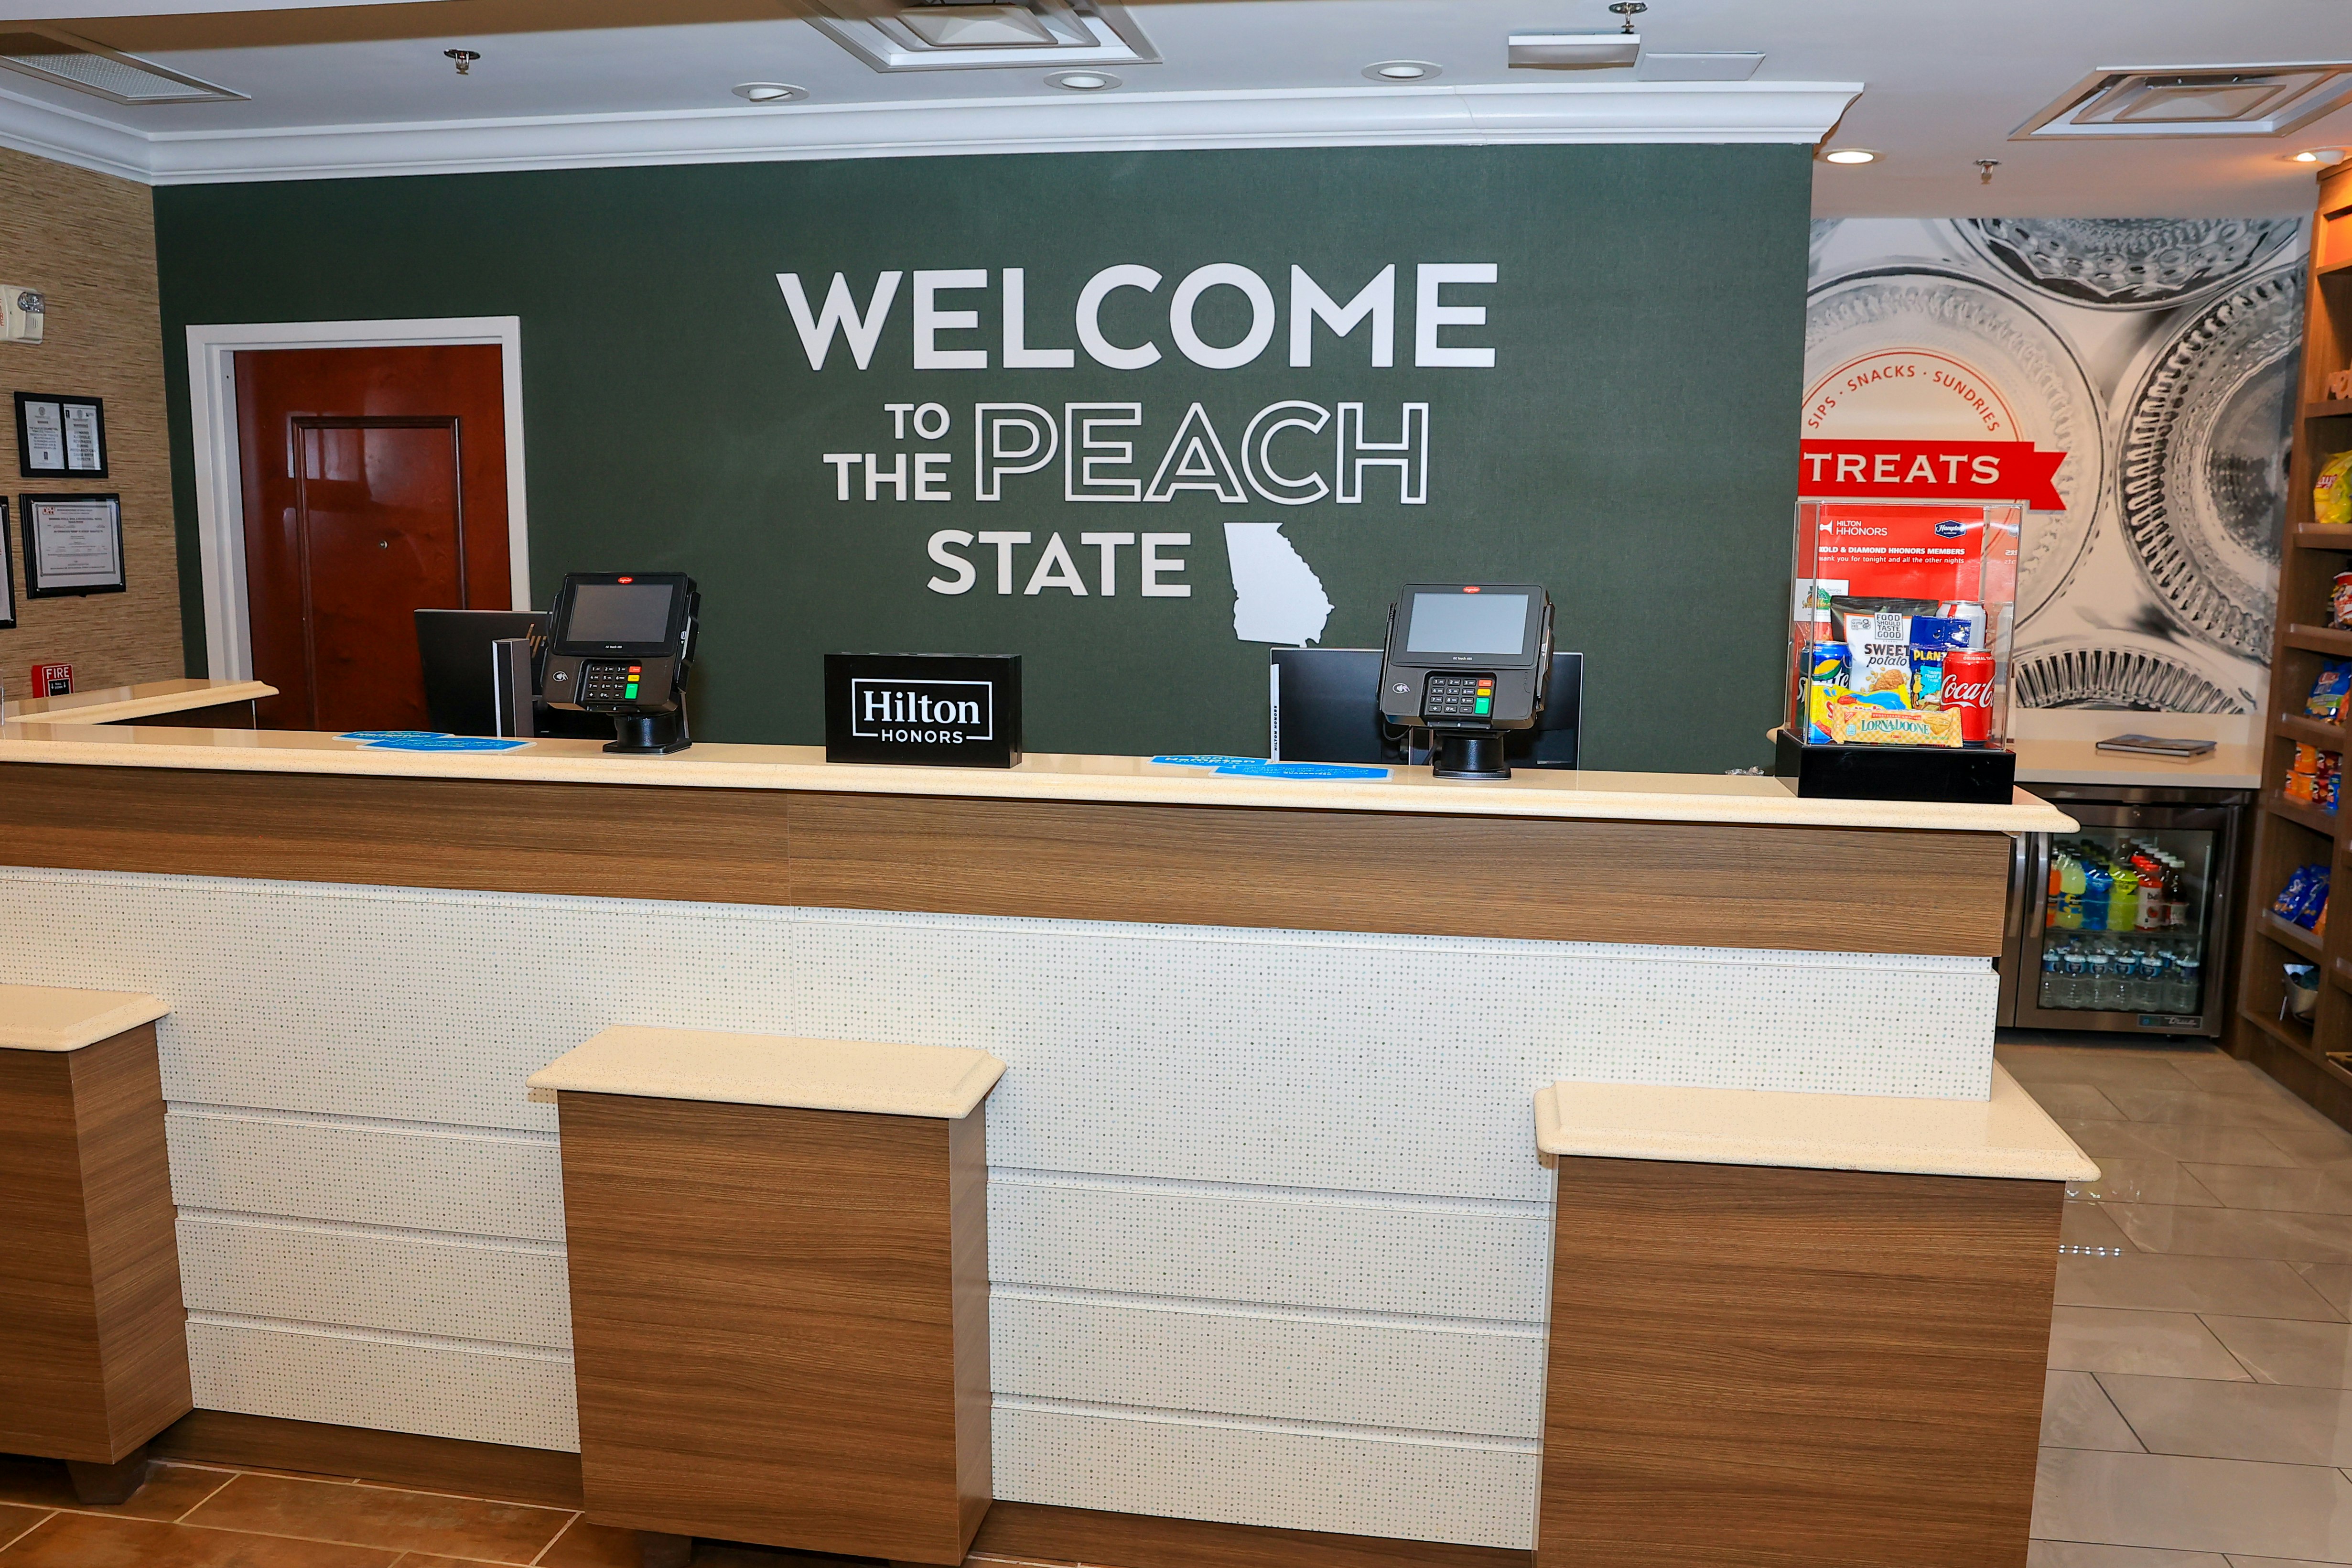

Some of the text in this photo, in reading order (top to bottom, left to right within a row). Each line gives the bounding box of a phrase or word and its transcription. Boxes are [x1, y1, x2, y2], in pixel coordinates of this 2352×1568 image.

[776, 263, 1497, 370] WELCOME
[1808, 365, 2000, 432] SIPS SNACKS SUNDRIES
[885, 403, 949, 439] TO
[823, 400, 1428, 505] THE PEACH
[1804, 452, 2000, 484] TREATS
[1836, 527, 1888, 536] HHONORS
[928, 530, 1190, 596] STATE
[1865, 643, 1910, 657] SWEET
[1866, 655, 1907, 668] potato
[46, 667, 69, 679] FIRE
[863, 691, 981, 724] Hilton
[882, 729, 963, 743] HONORS
[1861, 719, 1930, 735] LORNA DOONE
